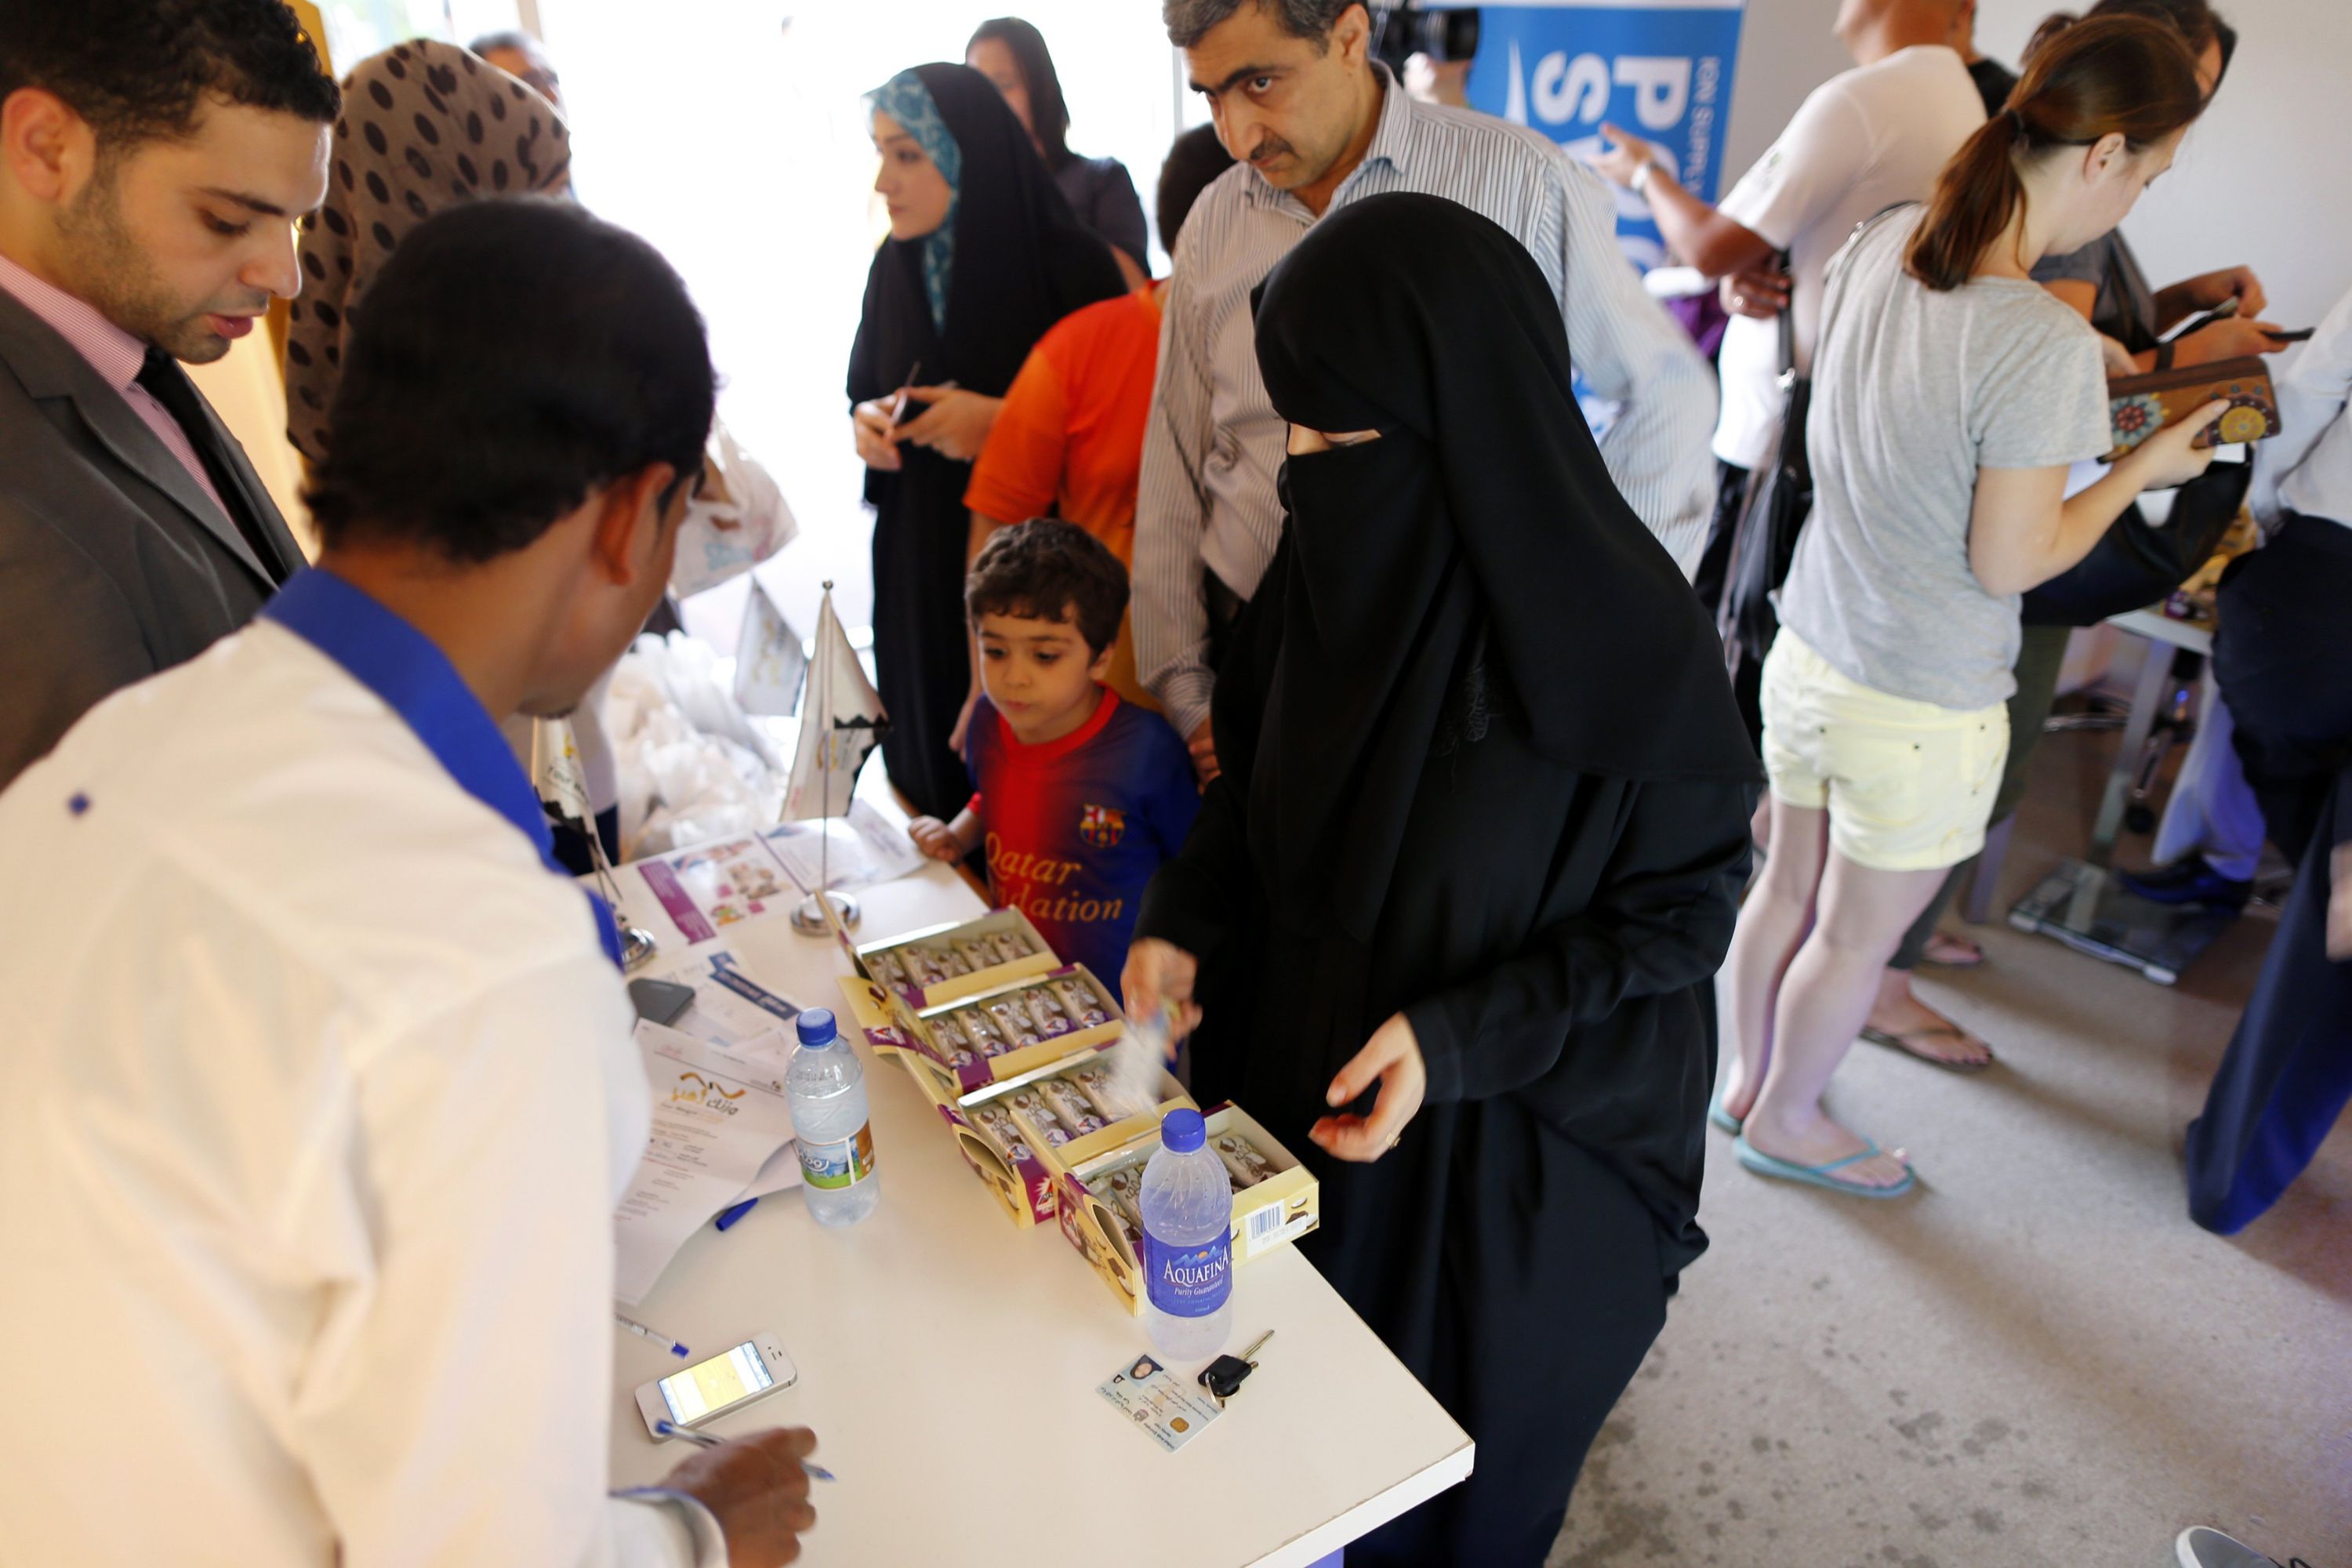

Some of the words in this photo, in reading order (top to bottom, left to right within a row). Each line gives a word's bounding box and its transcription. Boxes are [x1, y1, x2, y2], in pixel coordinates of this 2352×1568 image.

[1694, 56, 1721, 104] ION
[985, 832, 1082, 885] Qatar
[1000, 884, 1123, 921] dation
[1163, 1245, 1229, 1287] AQUAFINA
[1174, 1287, 1192, 1298] Purity
